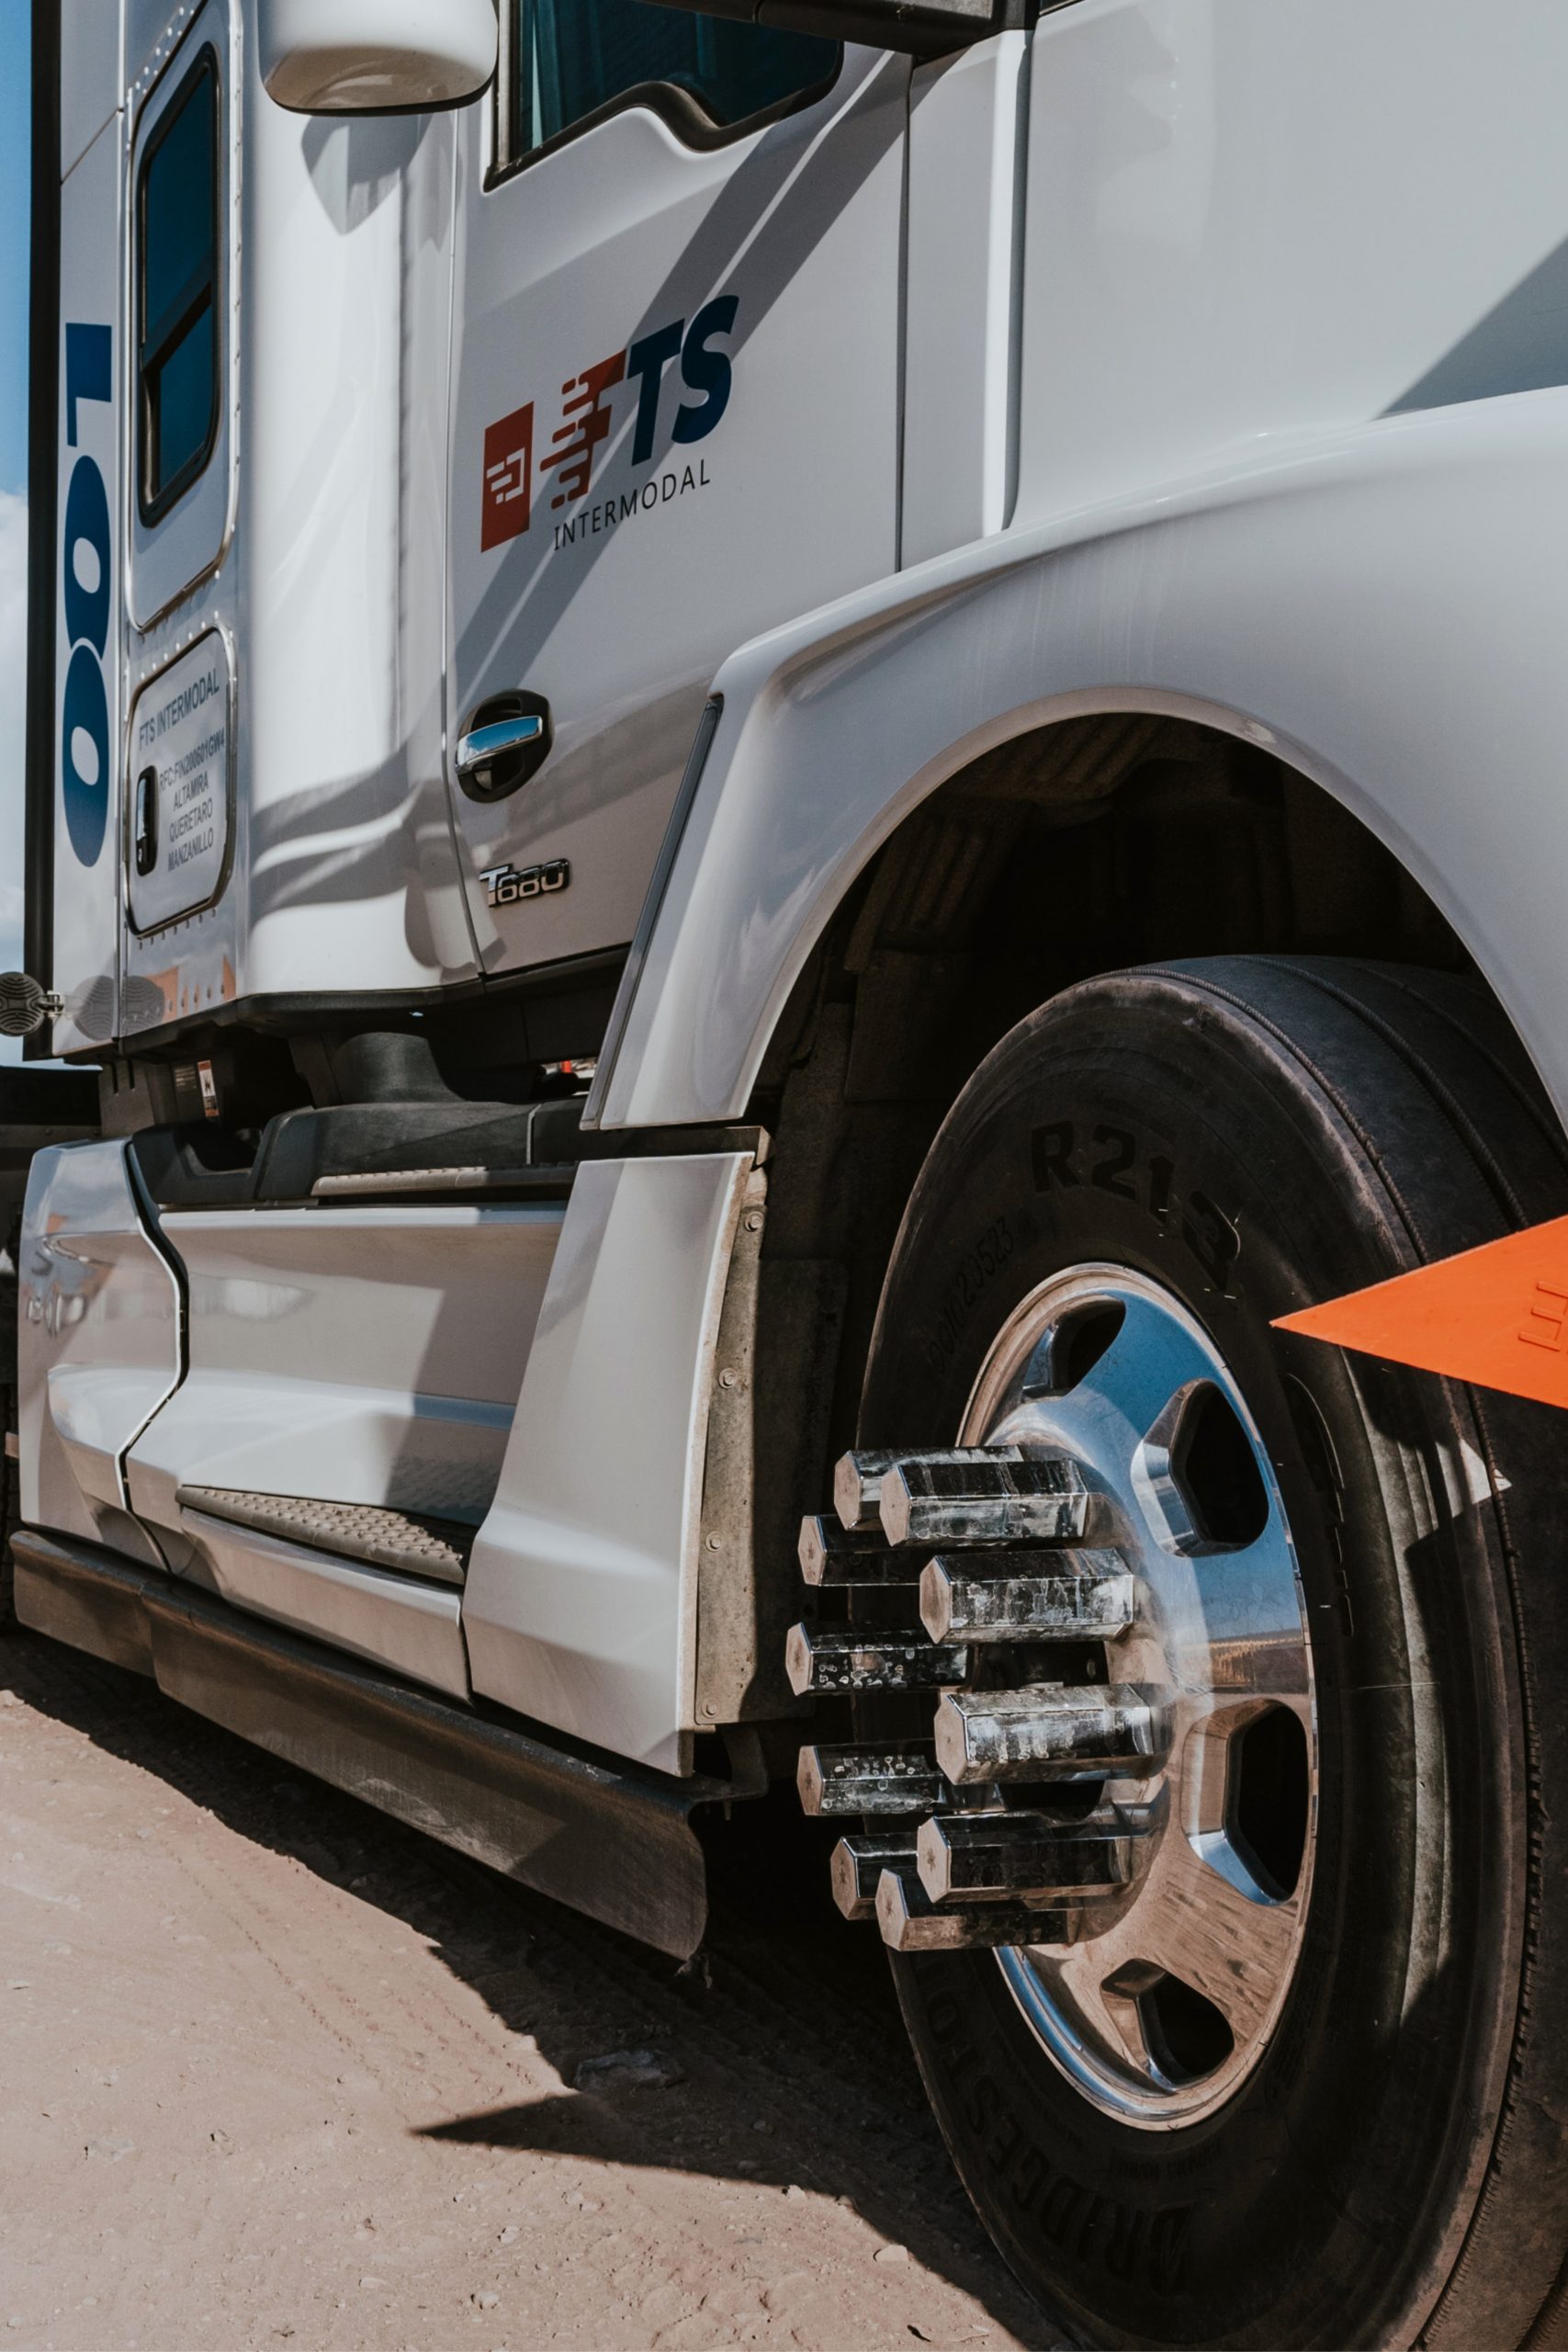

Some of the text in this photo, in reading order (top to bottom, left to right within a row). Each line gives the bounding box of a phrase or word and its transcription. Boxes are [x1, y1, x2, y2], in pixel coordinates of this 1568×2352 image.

[540, 295, 739, 509] FTS
[554, 459, 711, 550] INTERMODAL
[139, 668, 220, 751] FTS INTERMODAL
[173, 771, 209, 811] ALTAMIRA
[169, 798, 213, 842] QUERETARO
[168, 828, 214, 872] MANZANILLO
[479, 859, 570, 907] T680
